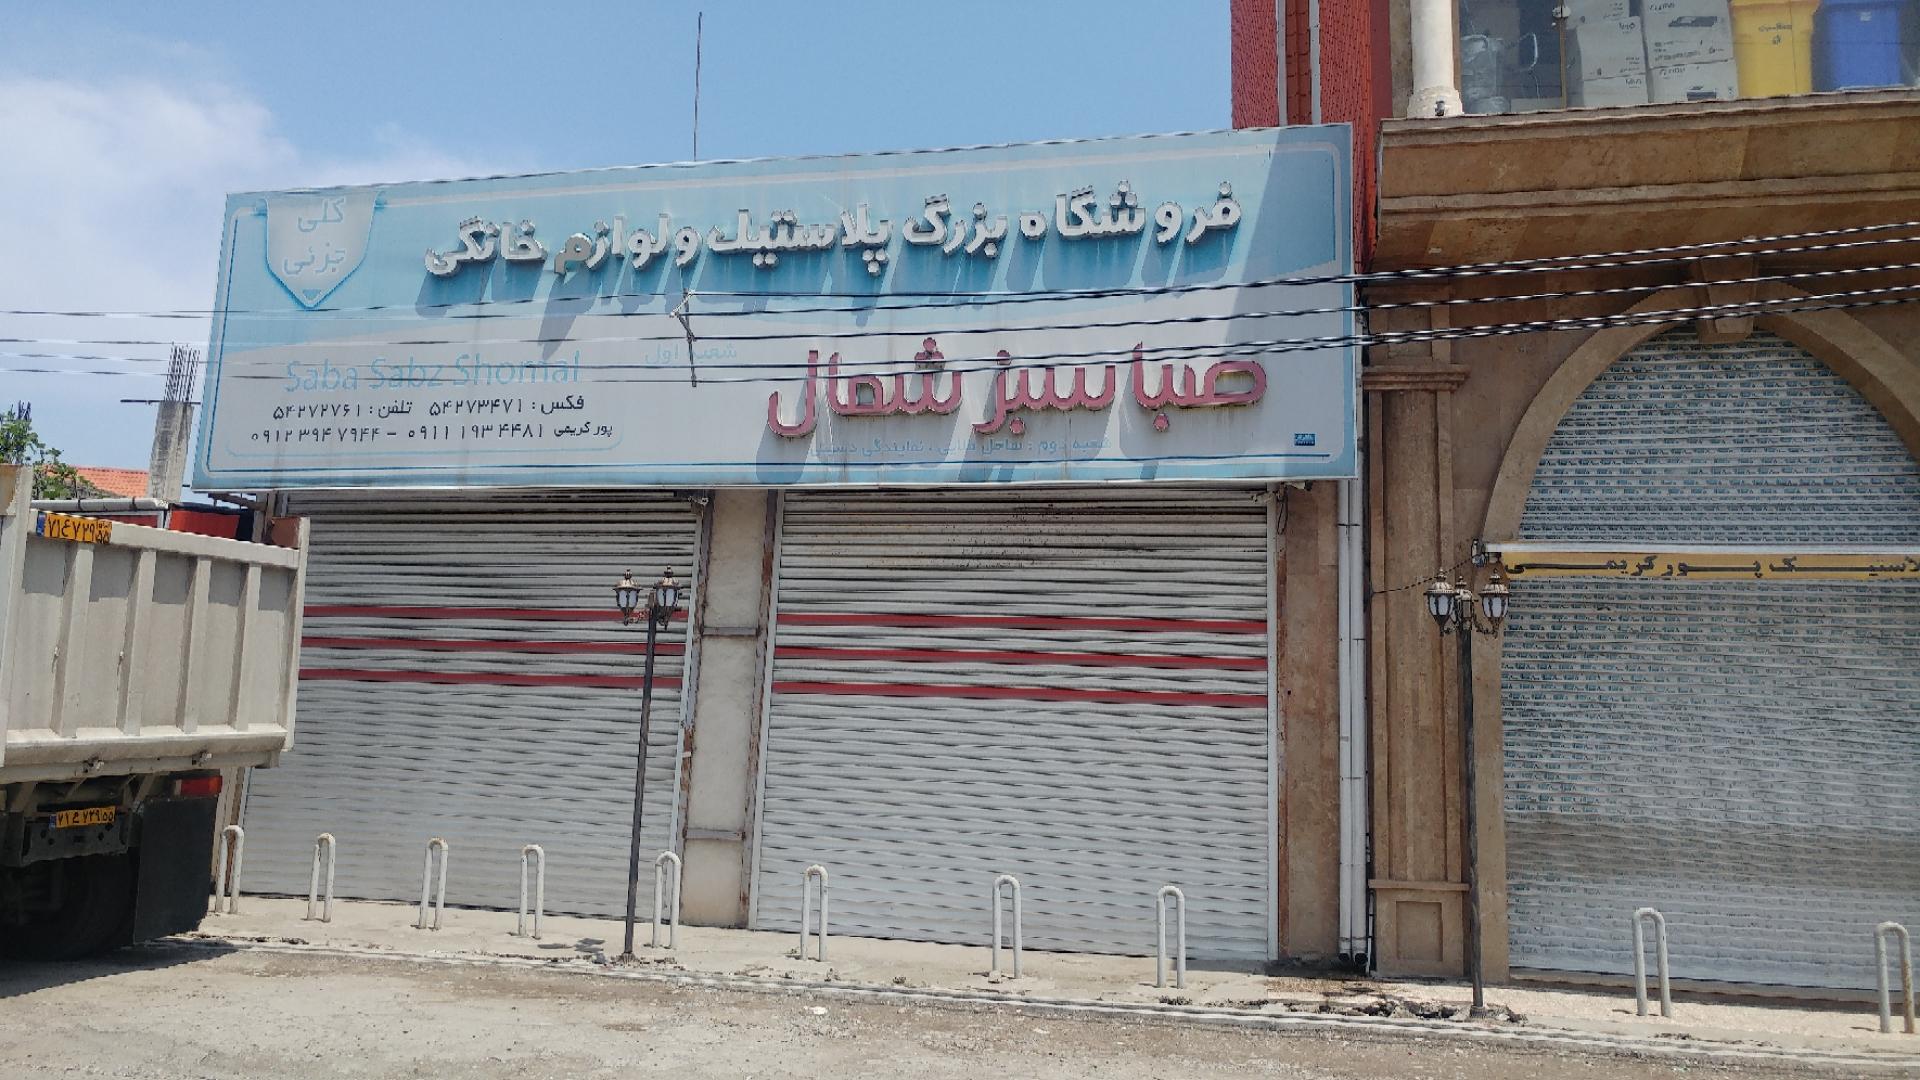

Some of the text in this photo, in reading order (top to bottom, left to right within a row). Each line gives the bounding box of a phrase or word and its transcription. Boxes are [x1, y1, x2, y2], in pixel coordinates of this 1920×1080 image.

[297, 198, 346, 233] کلی
[707, 203, 894, 277] پلاستیک
[903, 193, 1009, 259] بزرگ
[1019, 179, 1242, 245] فروشگاه
[424, 215, 548, 277] خانگی
[284, 349, 581, 393] Saba Sabz Shomal
[768, 336, 1268, 437] صبا سبز شمال
[272, 403, 361, 420] ۵۴۲۷۲۷۶۱
[429, 399, 522, 416] ۵۴۲۷۳۴۷۱
